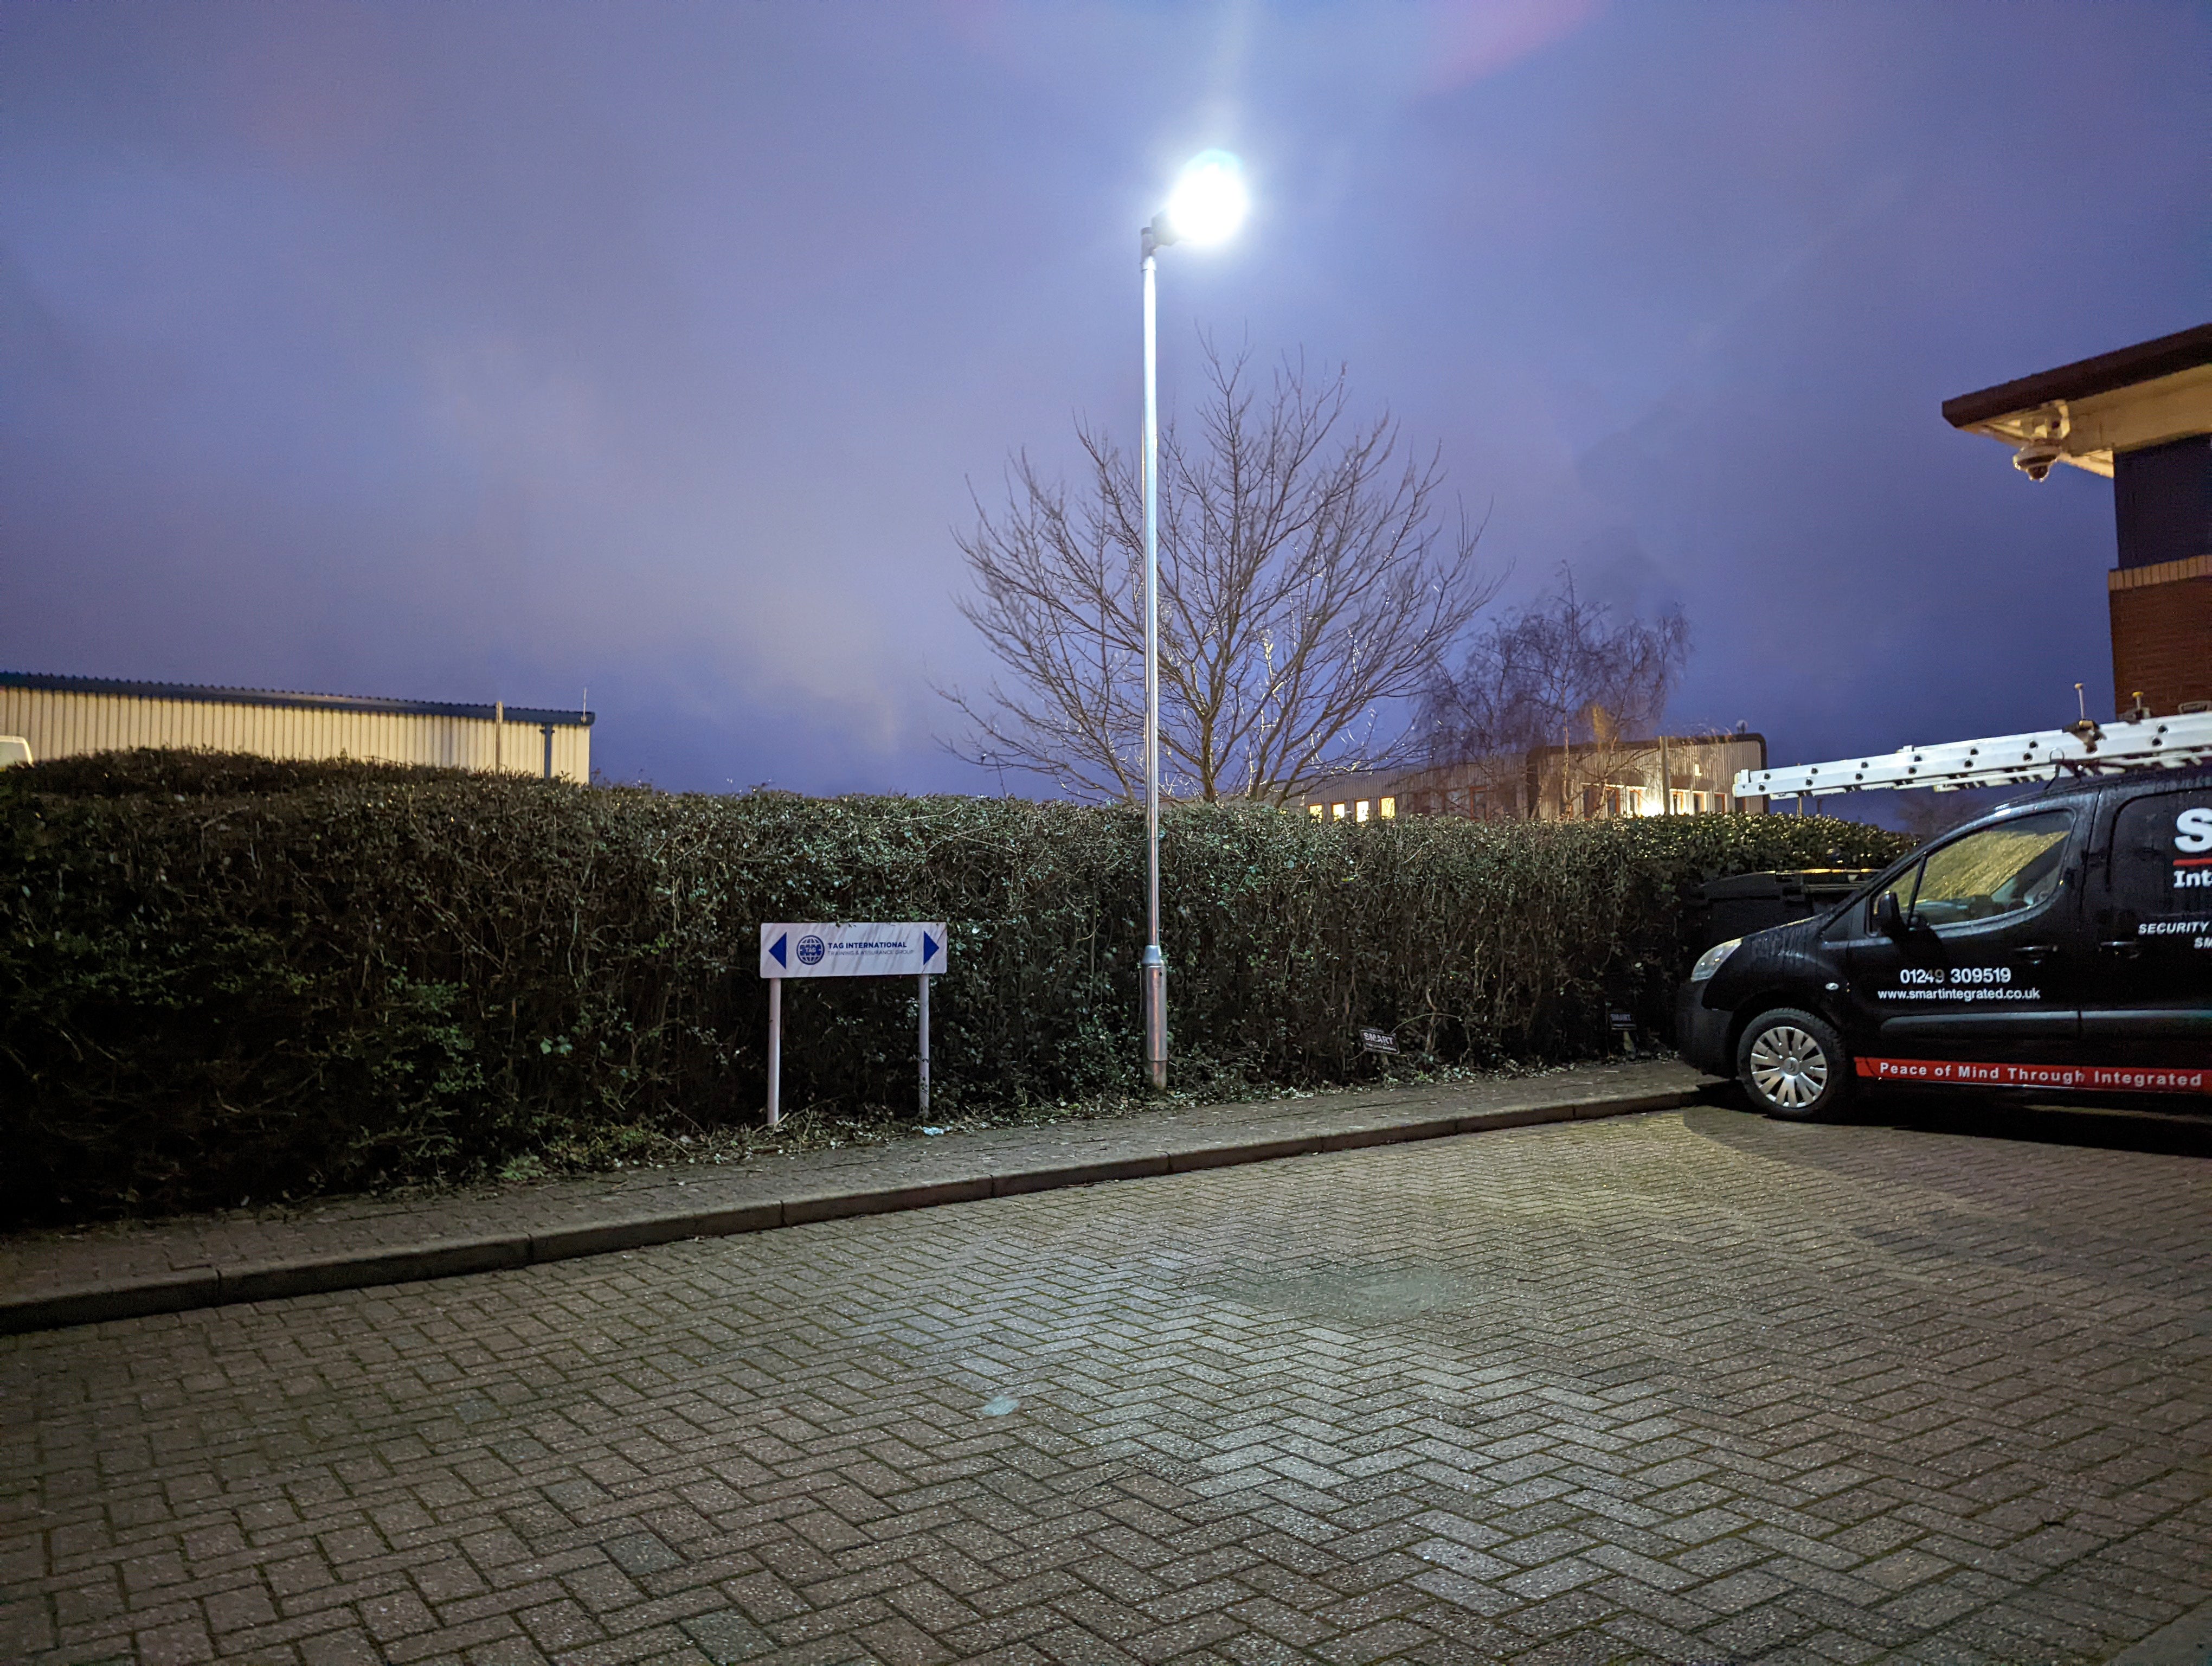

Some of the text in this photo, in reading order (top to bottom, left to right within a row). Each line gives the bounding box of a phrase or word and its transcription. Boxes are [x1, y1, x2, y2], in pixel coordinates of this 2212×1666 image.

[2138, 921, 2210, 935] SECURITY
[1900, 967, 2011, 984] 01249 309519
[1877, 988, 2041, 1002] www.smartintegrated.co.uk
[1364, 1032, 1393, 1045] SMART
[1880, 1062, 2202, 1087] Peace of Mind Through Integrated
